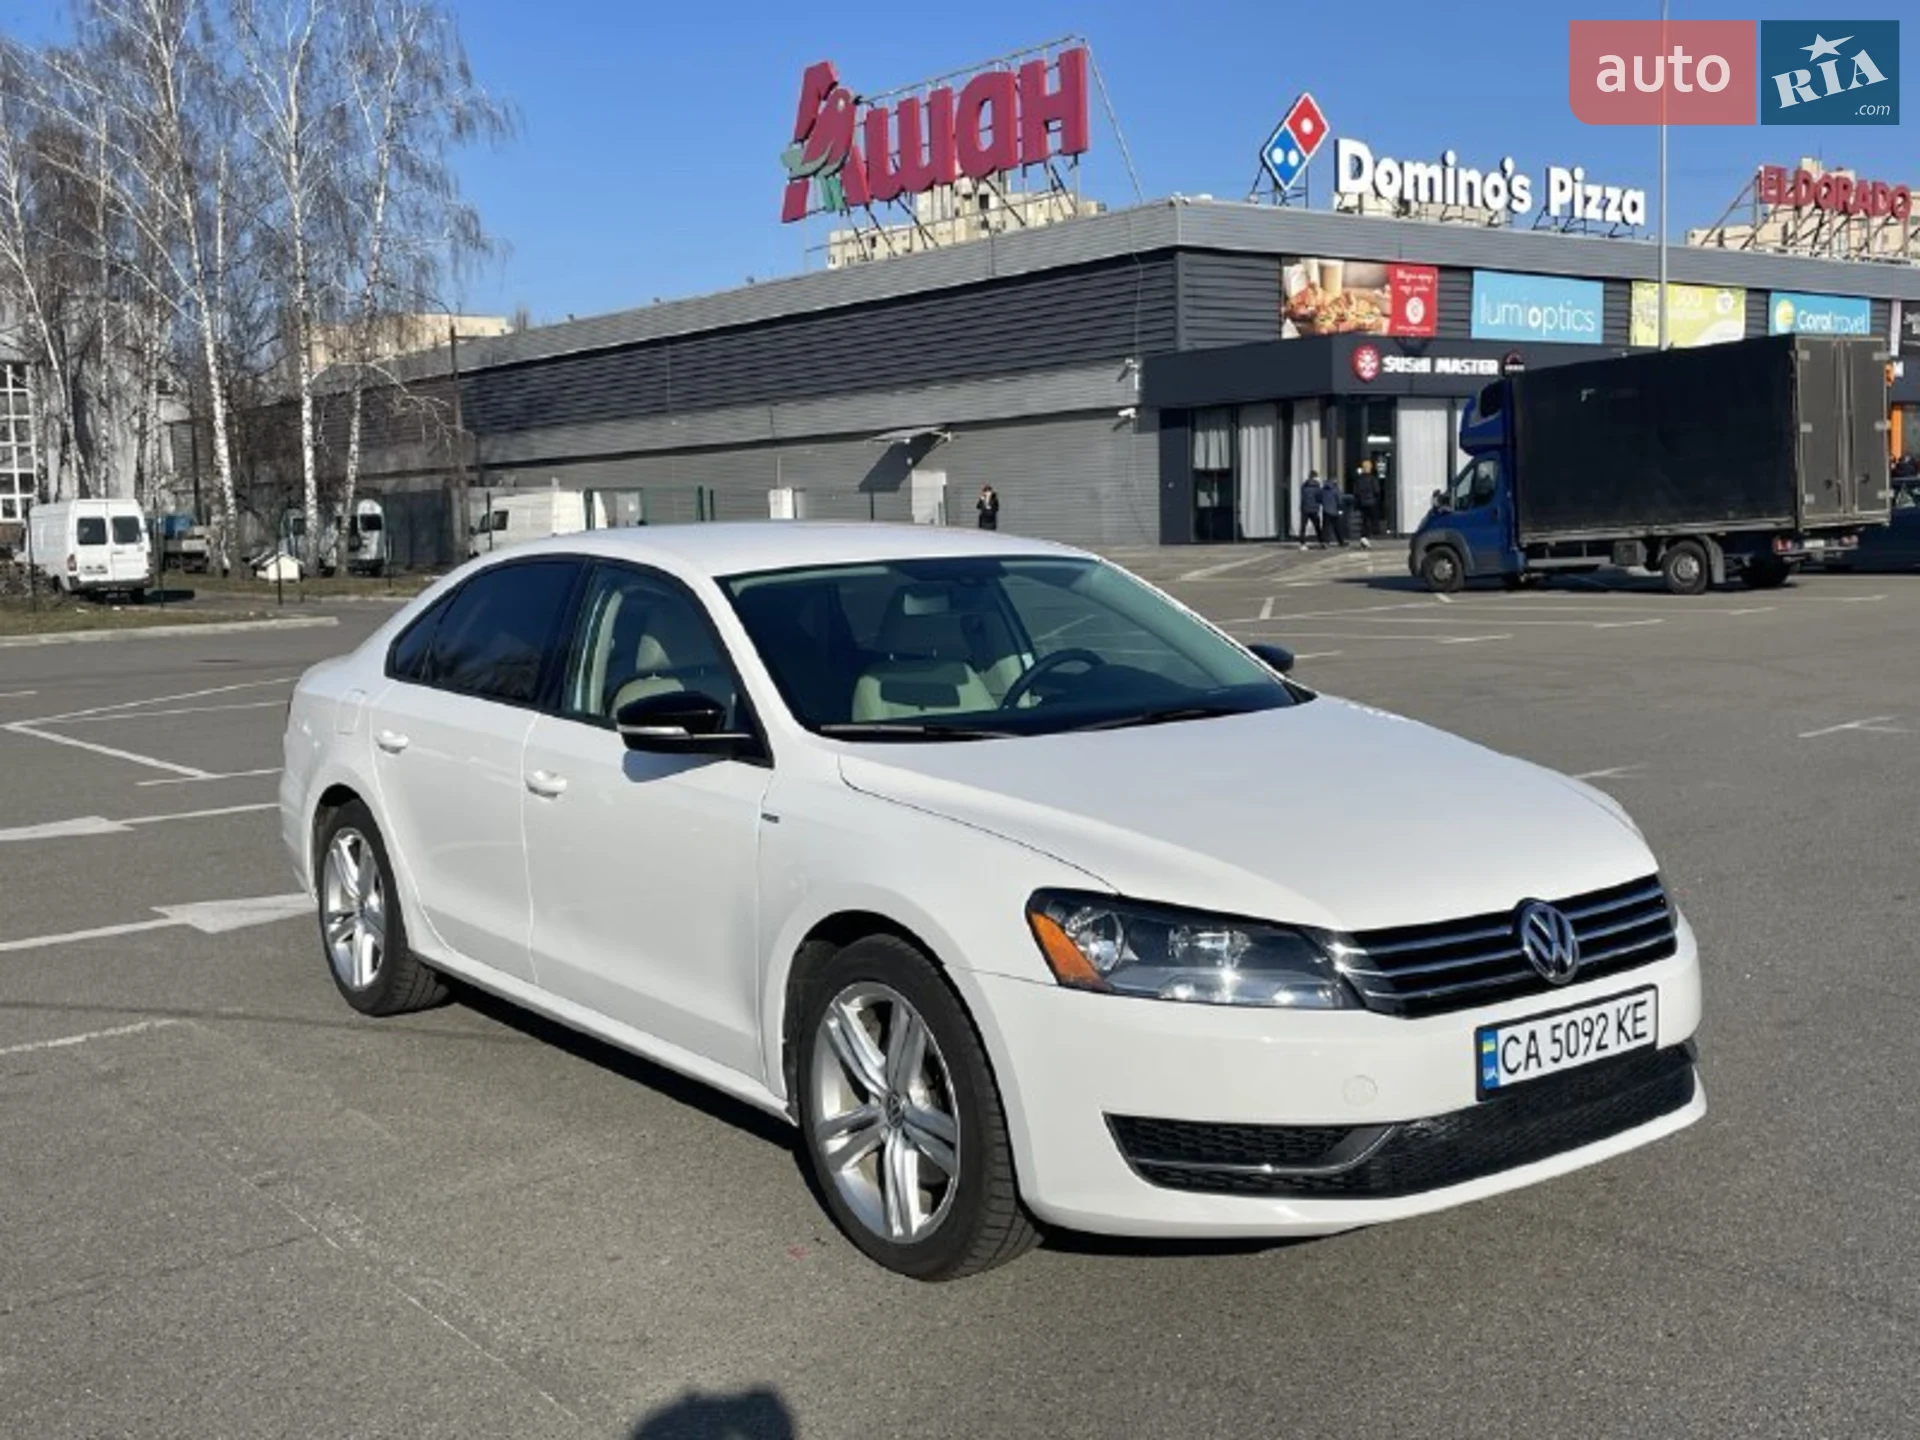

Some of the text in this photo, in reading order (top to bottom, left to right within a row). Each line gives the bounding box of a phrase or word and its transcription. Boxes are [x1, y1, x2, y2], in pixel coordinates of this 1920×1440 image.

[1334, 138, 1646, 226] Domino's Pizza
[1760, 164, 1912, 221] ELDORADO
[1480, 291, 1596, 336] lumioptics
[1382, 355, 1500, 376] SUSHI MASTER
[1501, 999, 1648, 1076] CA 5092 KE
